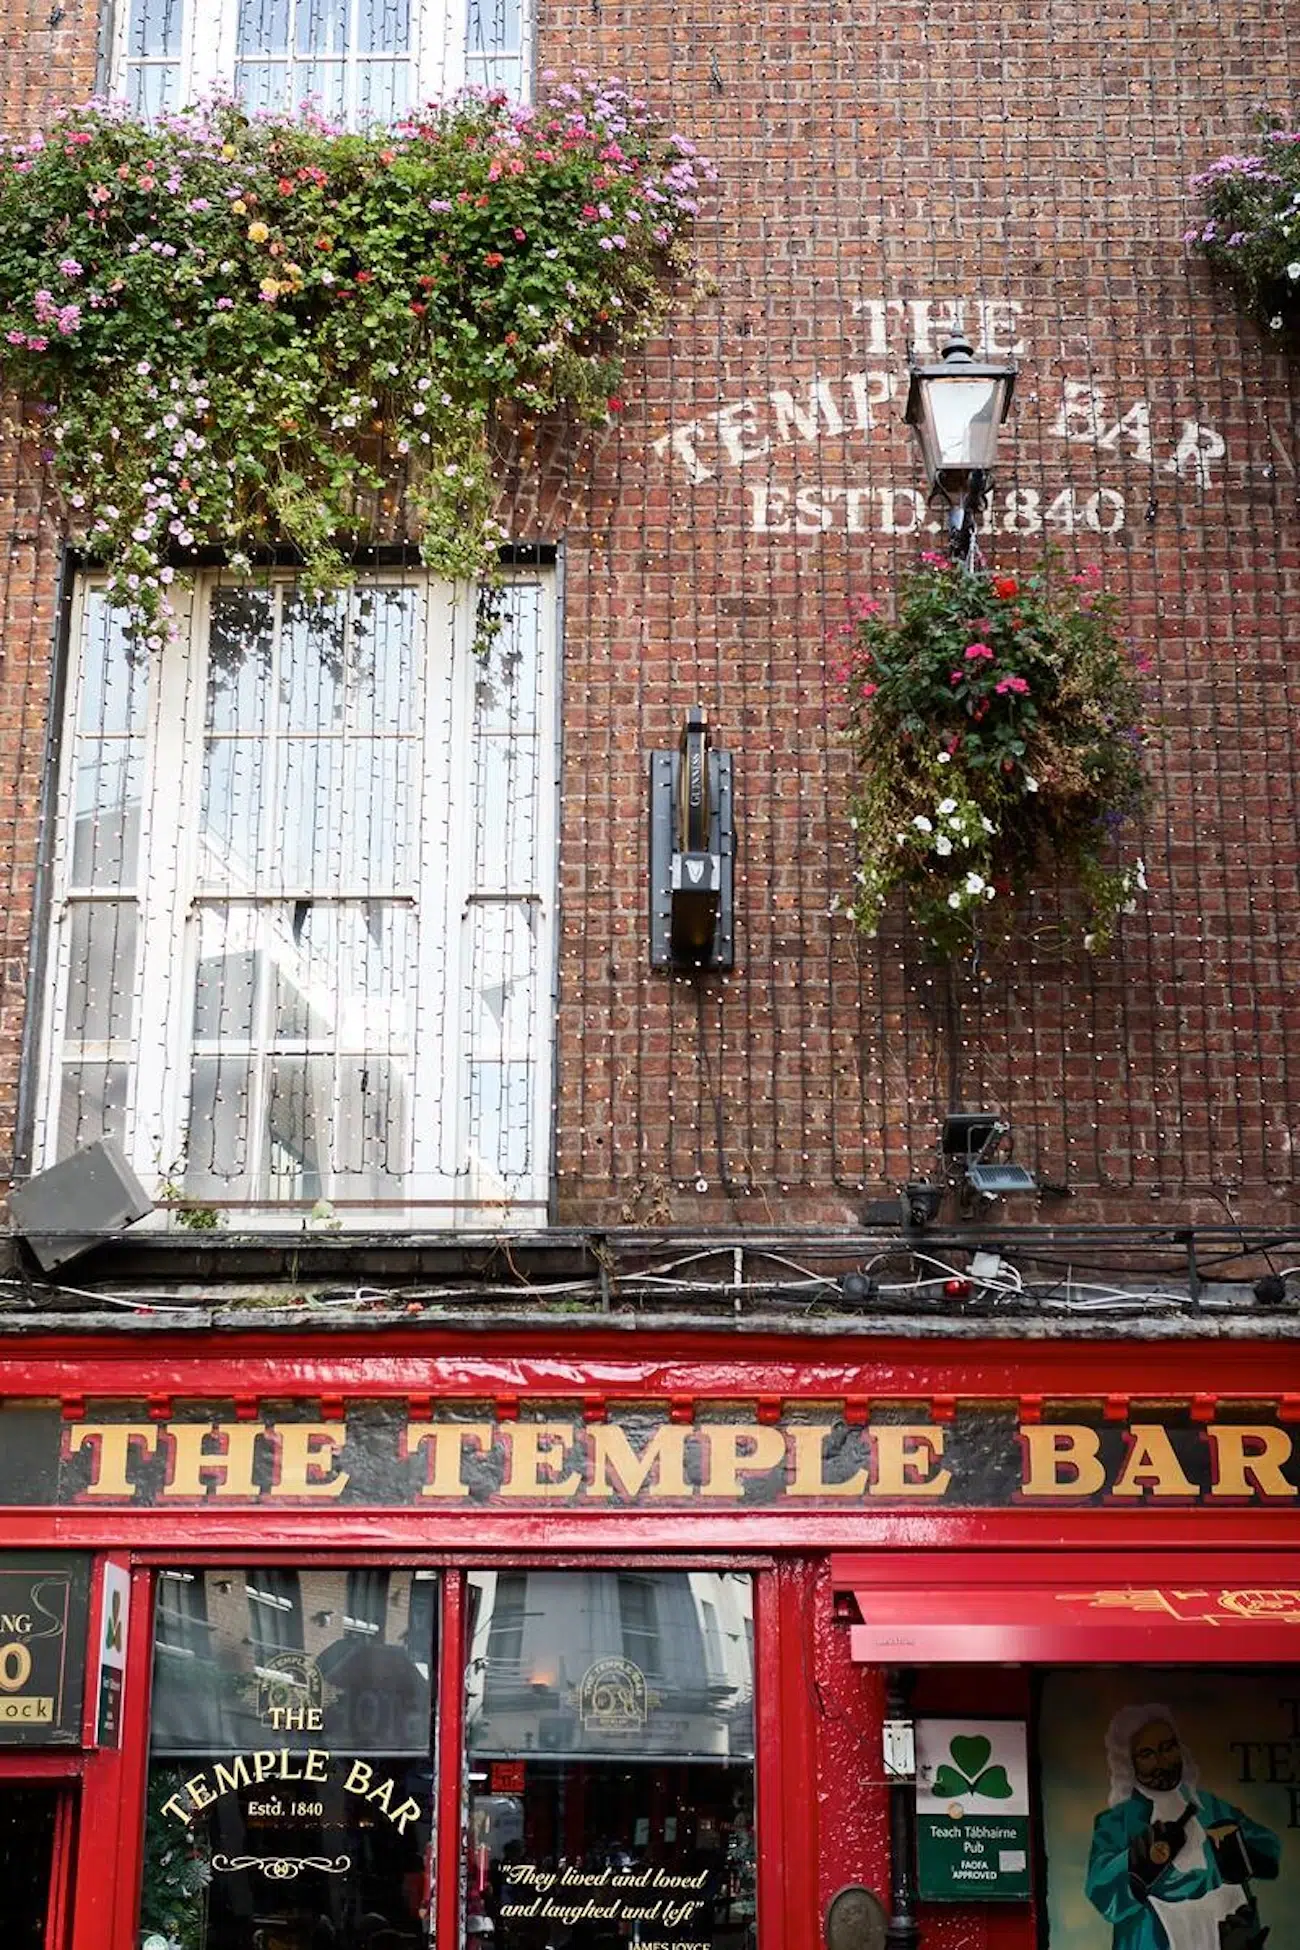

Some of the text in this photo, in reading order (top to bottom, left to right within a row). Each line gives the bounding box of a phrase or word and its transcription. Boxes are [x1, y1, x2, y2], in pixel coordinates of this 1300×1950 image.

[856, 299, 1025, 355] THE
[652, 370, 1226, 490] TEMP BAR
[745, 486, 1126, 534] ESTD. 1840
[689, 753, 702, 807] GUINNESS
[68, 1422, 1299, 1497] THE TEMPLE BAR
[267, 1707, 324, 1731] THE
[160, 1747, 331, 1827] TEMPLE
[343, 1759, 422, 1836] BAR
[248, 1801, 324, 1817] Estd. 1840
[930, 1825, 1018, 1839] Teach Tábhairne
[963, 1841, 985, 1854] Pub
[561, 1866, 612, 1887] lived
[612, 1867, 652, 1888] and
[652, 1868, 709, 1890] loved
[951, 1871, 998, 1880] APPROVED
[499, 1897, 542, 1918] and
[541, 1897, 622, 1925] laughed
[621, 1899, 662, 1920] and
